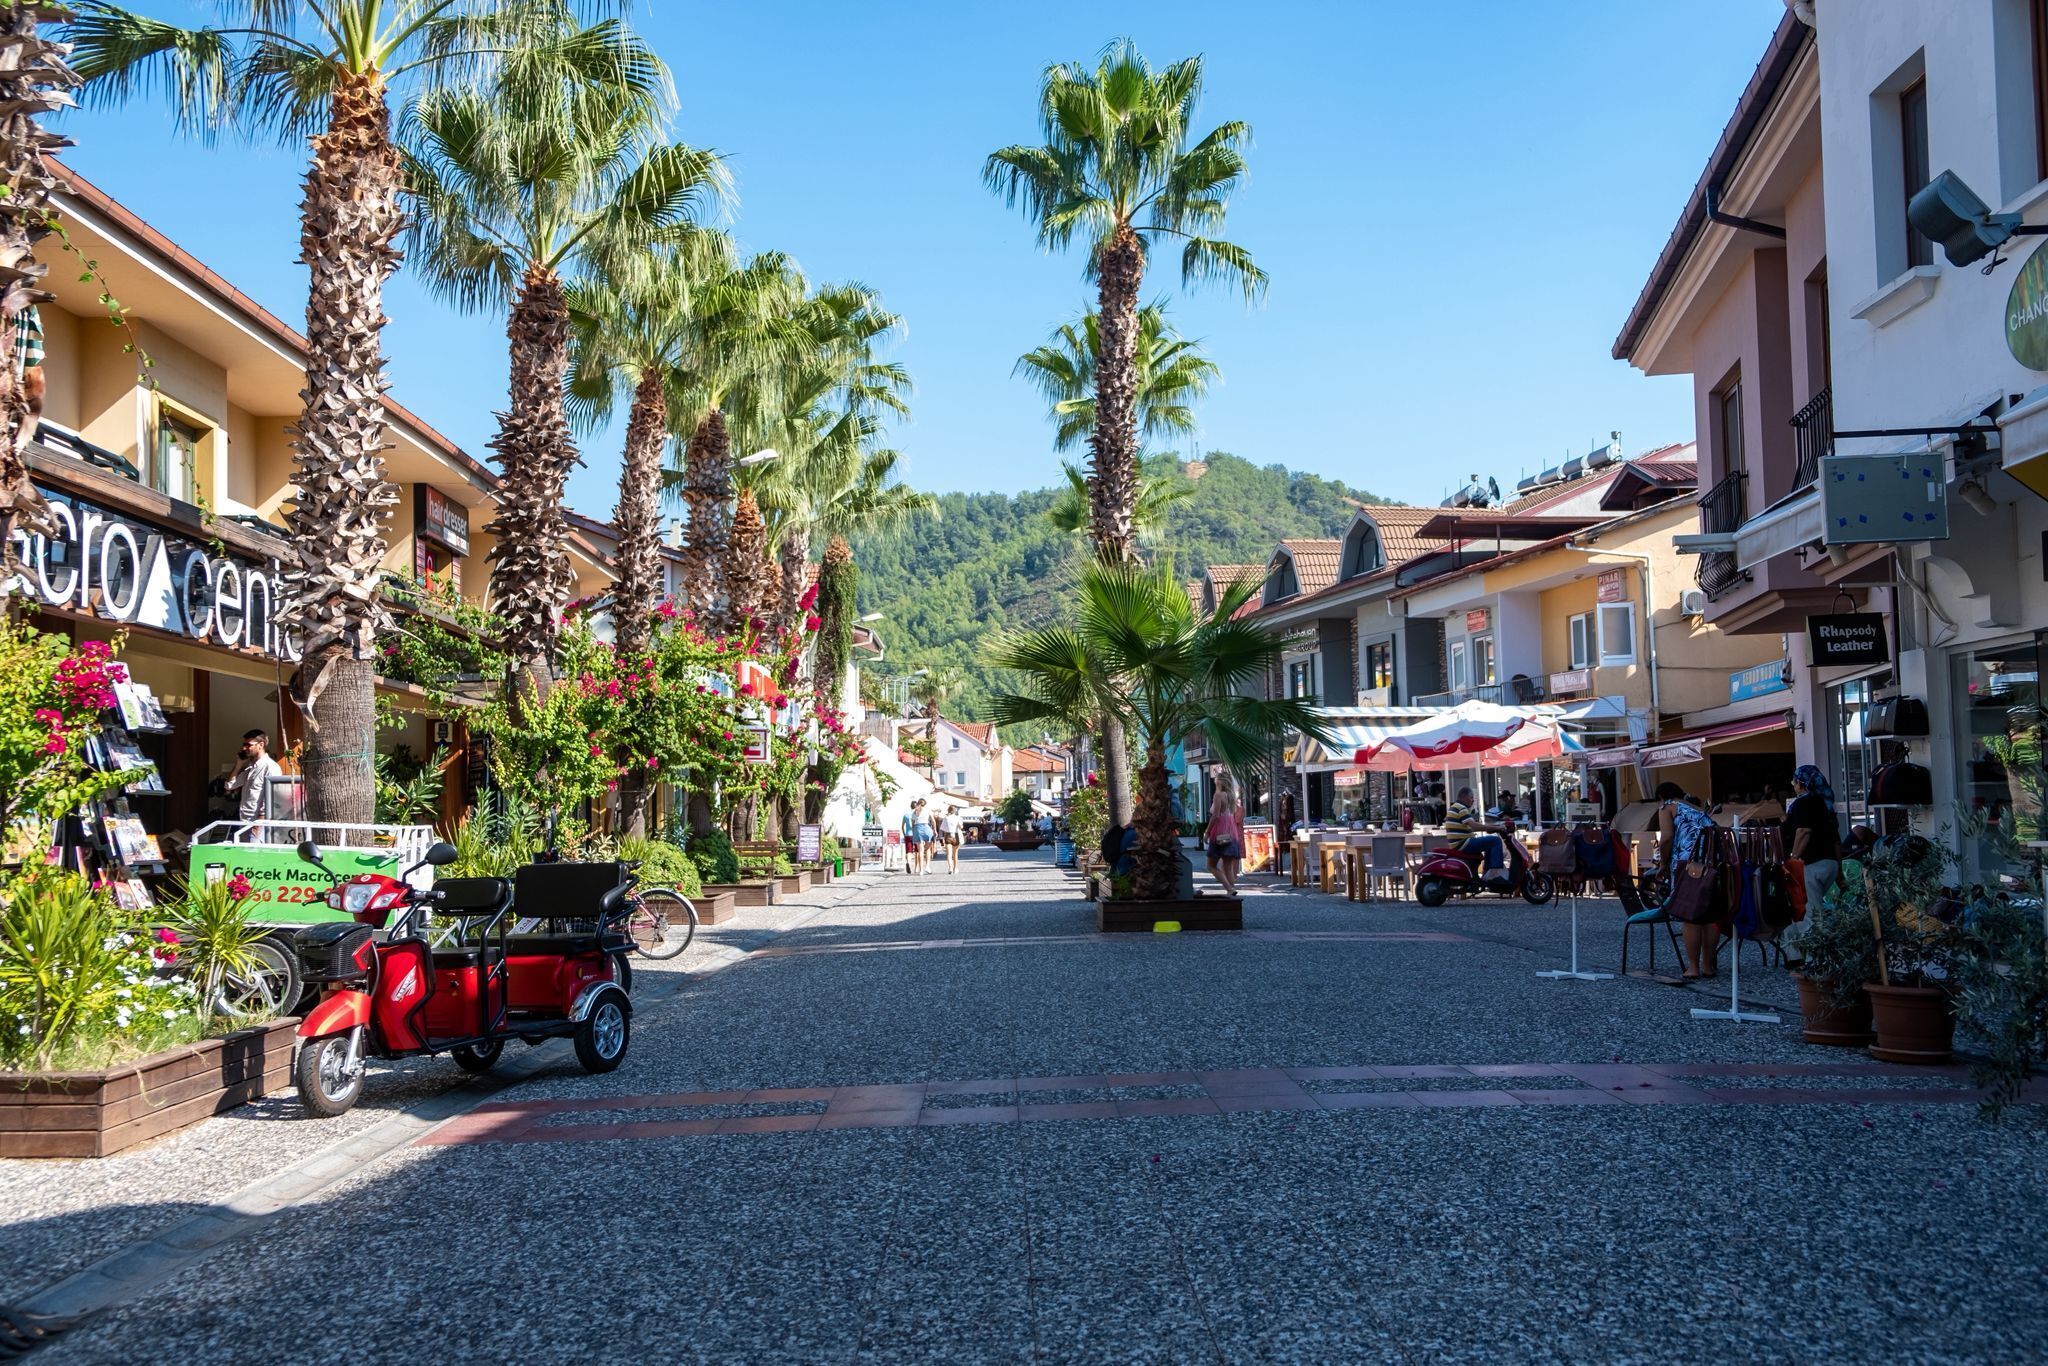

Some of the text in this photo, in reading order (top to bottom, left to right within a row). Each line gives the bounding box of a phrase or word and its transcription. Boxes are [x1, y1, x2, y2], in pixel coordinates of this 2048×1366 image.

[6, 501, 140, 620] acro
[1827, 640, 1874, 652] Leather
[233, 867, 281, 881] Göcek
